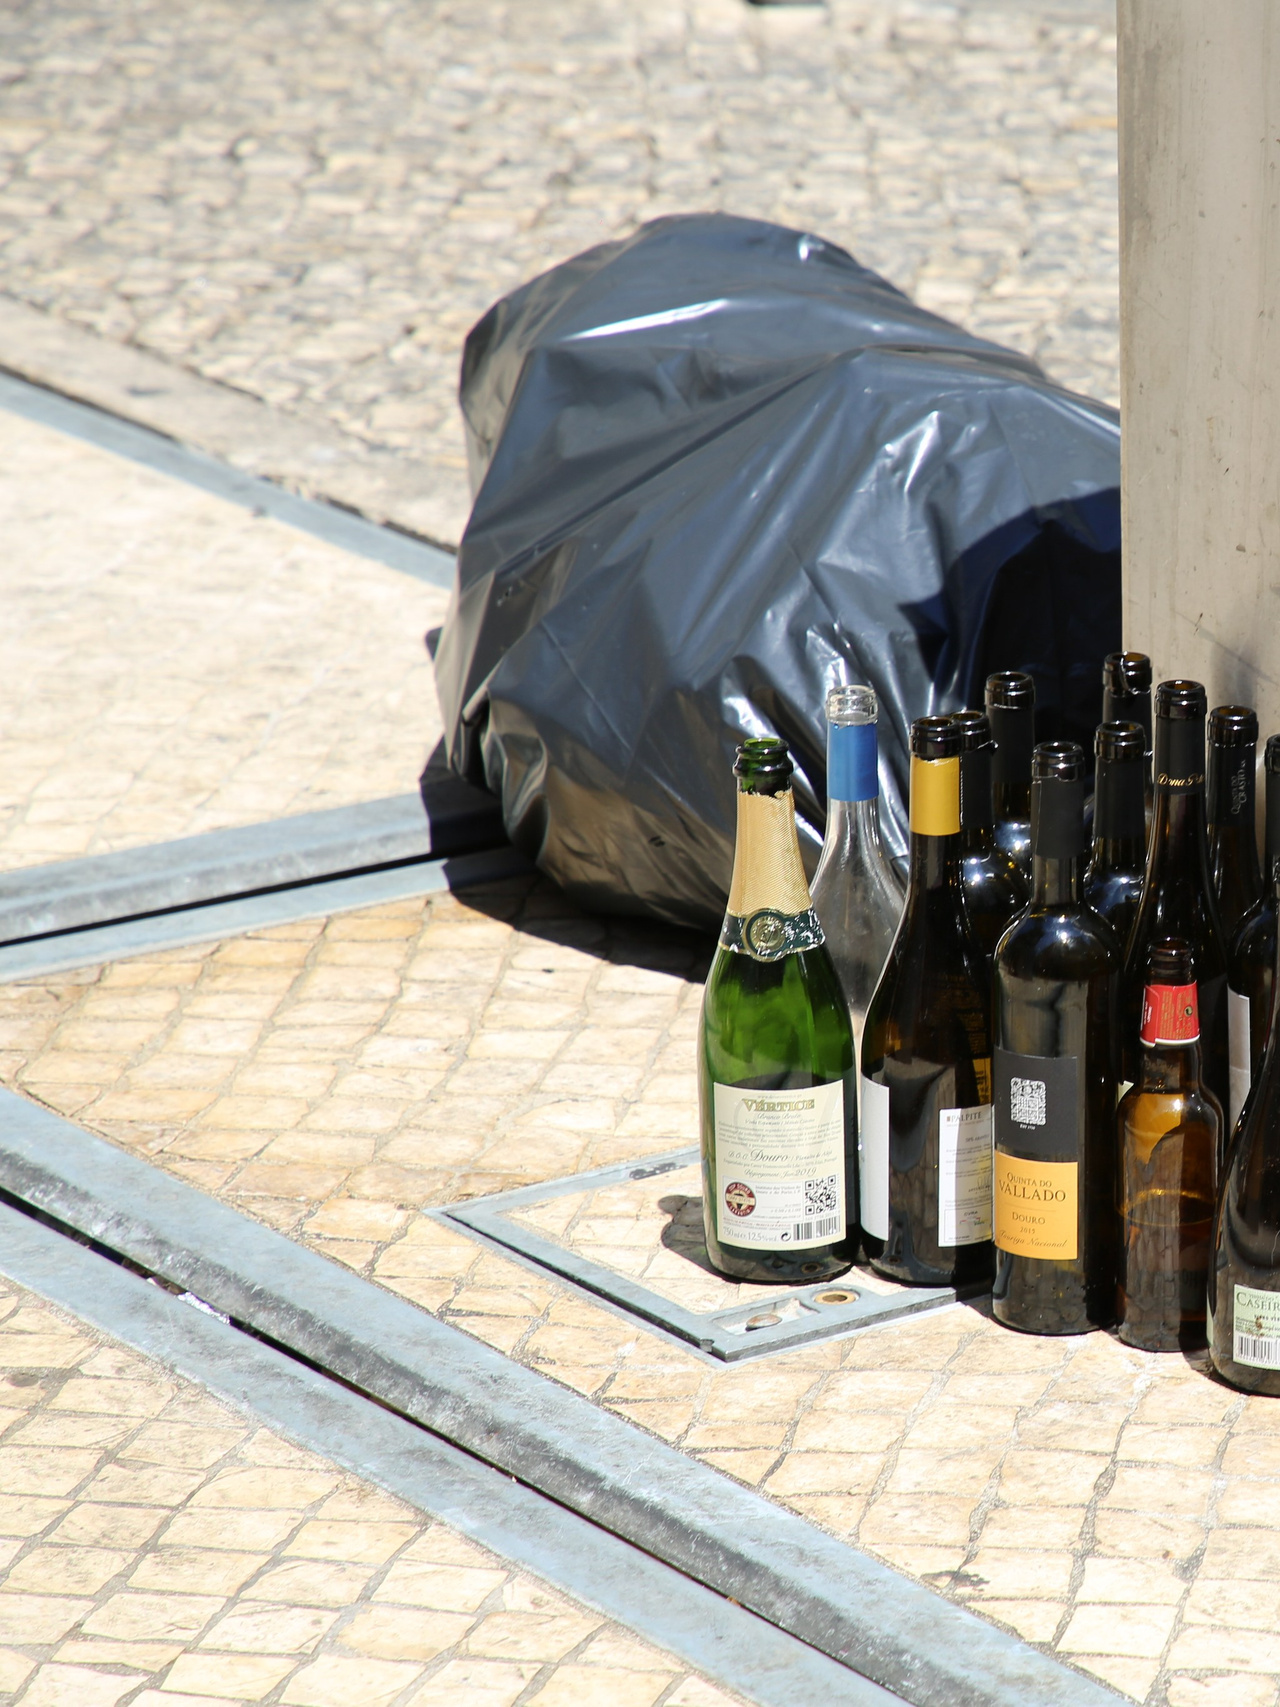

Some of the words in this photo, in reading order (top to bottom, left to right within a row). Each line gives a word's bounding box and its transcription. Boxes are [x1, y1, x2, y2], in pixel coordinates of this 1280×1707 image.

[742, 1098, 815, 1112] VÉRTICE
[950, 1111, 982, 1123] PALPITE
[750, 1148, 789, 1162] Douro
[794, 1167, 817, 1177] 2019
[1006, 1171, 1037, 1187] QUINTA
[1039, 1179, 1052, 1188] DO
[998, 1179, 1067, 1203] VALLADO
[1011, 1211, 1046, 1226] DOURO
[1019, 1226, 1036, 1235] 2015
[999, 1228, 1025, 1245] Touriga
[1026, 1236, 1068, 1249] Nacional
